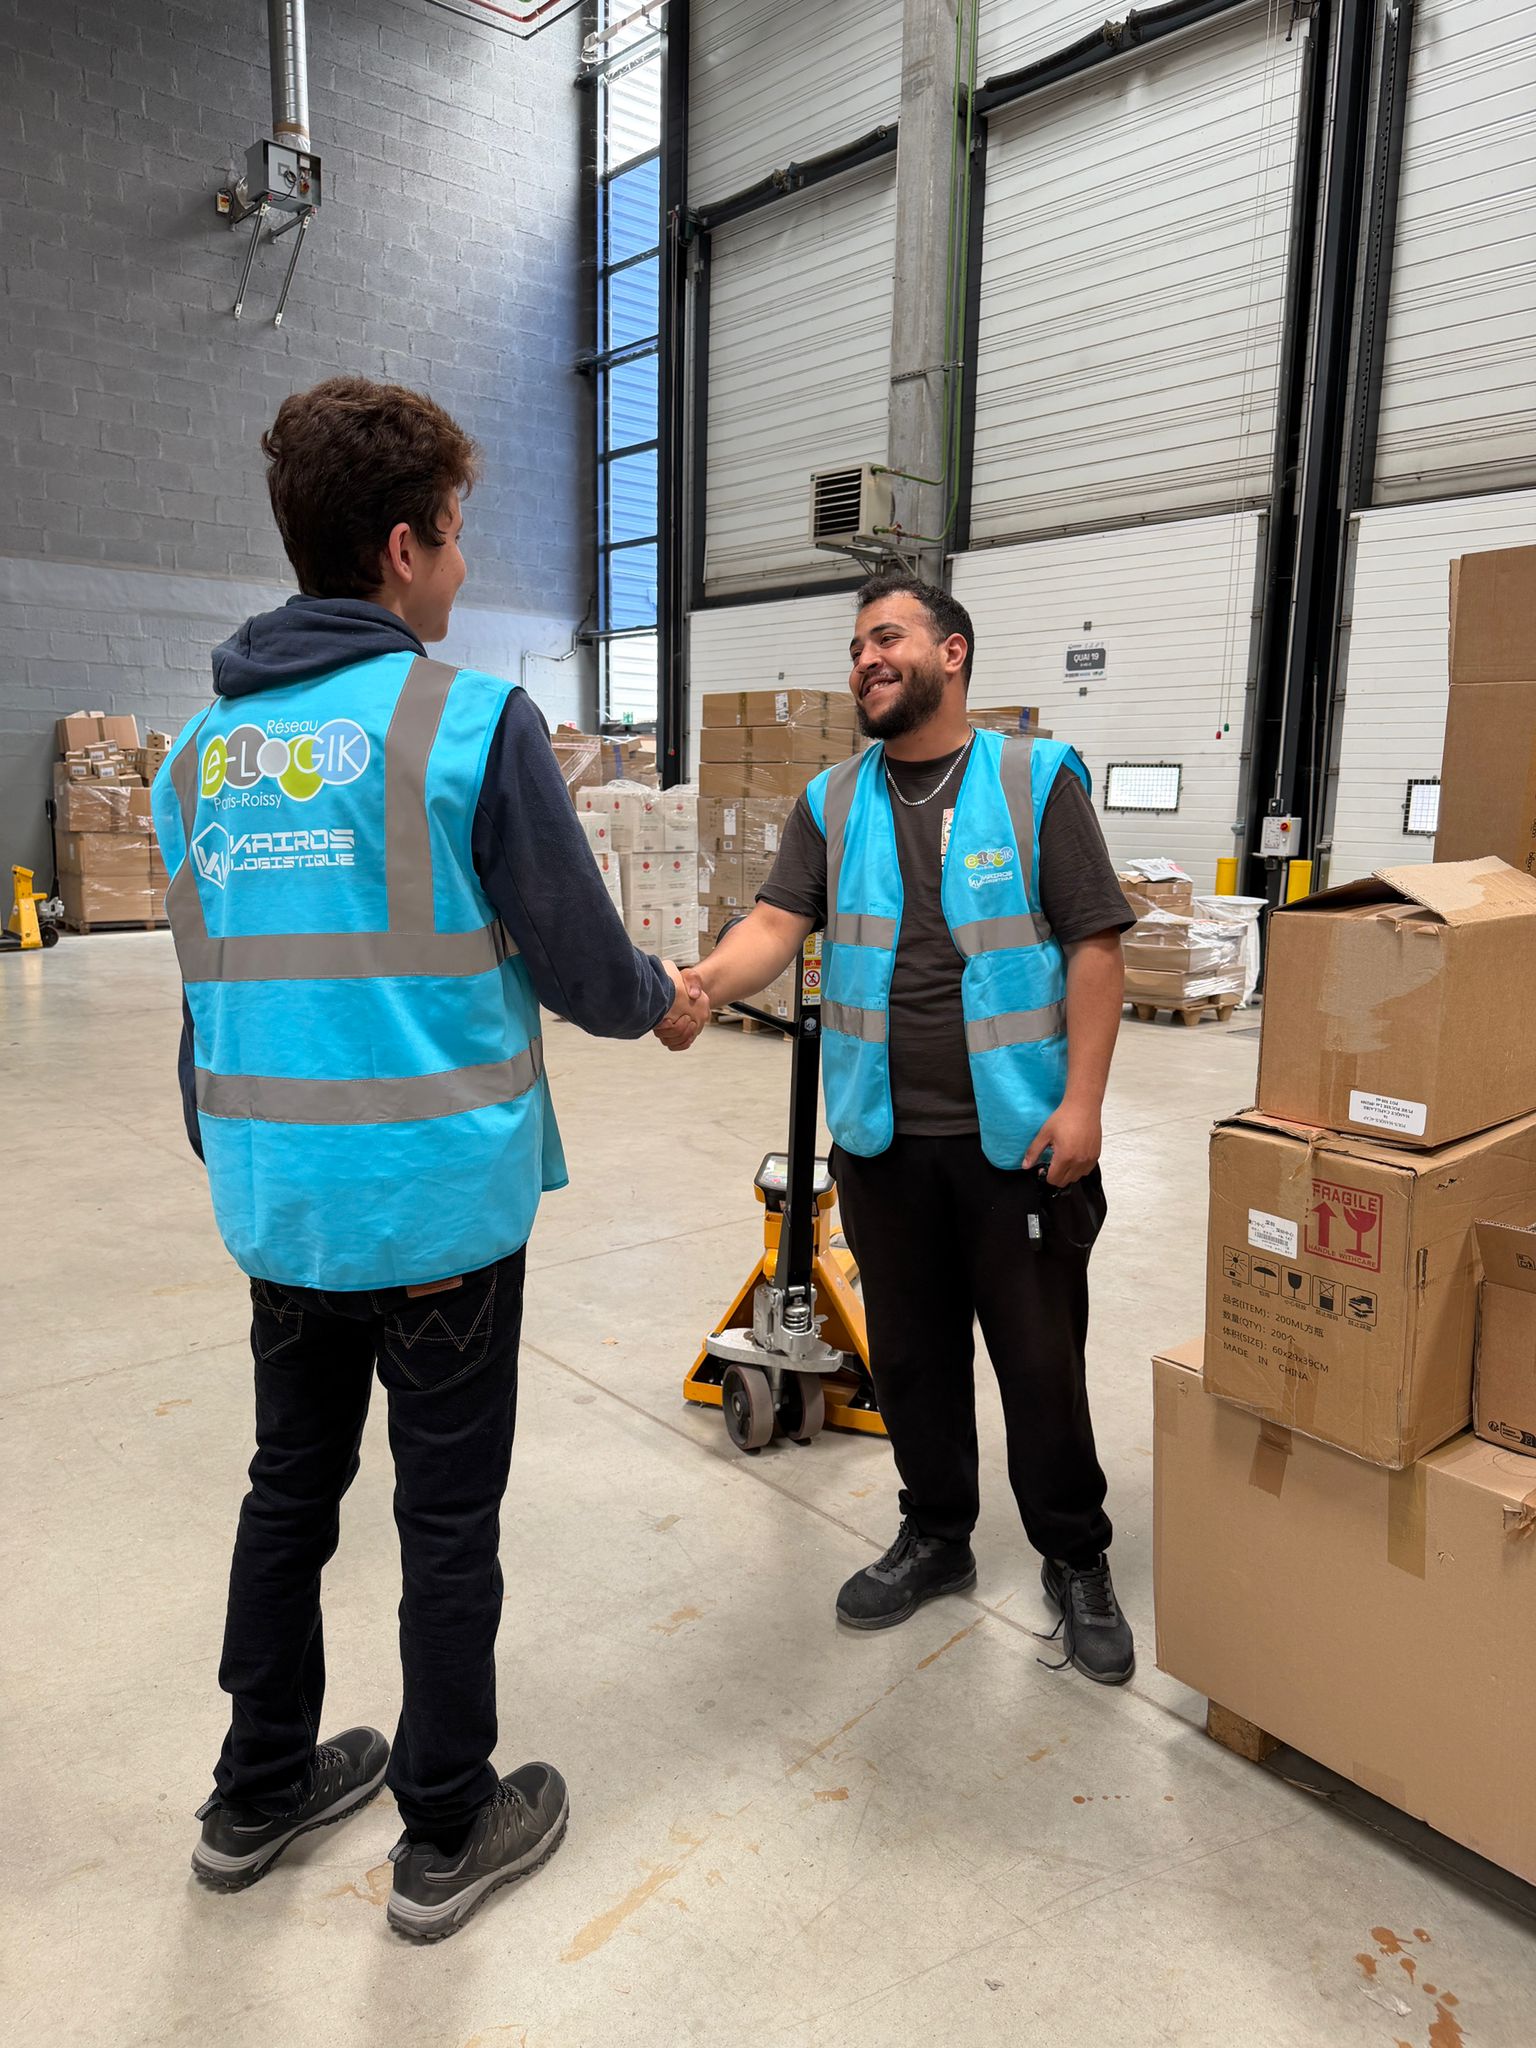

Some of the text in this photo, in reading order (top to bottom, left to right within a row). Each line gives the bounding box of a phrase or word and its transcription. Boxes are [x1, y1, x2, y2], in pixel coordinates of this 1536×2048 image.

[1074, 652, 1100, 663] QUAI 19
[266, 719, 319, 734] Réseau
[203, 730, 364, 786] e-LOGIK
[213, 792, 283, 811] Pais-Roissy
[230, 828, 355, 854] KAIROS
[230, 852, 355, 871] LOGISTIQUE
[1312, 1182, 1378, 1213] FRAGILE
[1308, 1243, 1336, 1257] HANDLE
[1223, 1341, 1309, 1381] MADE IN CHINA
